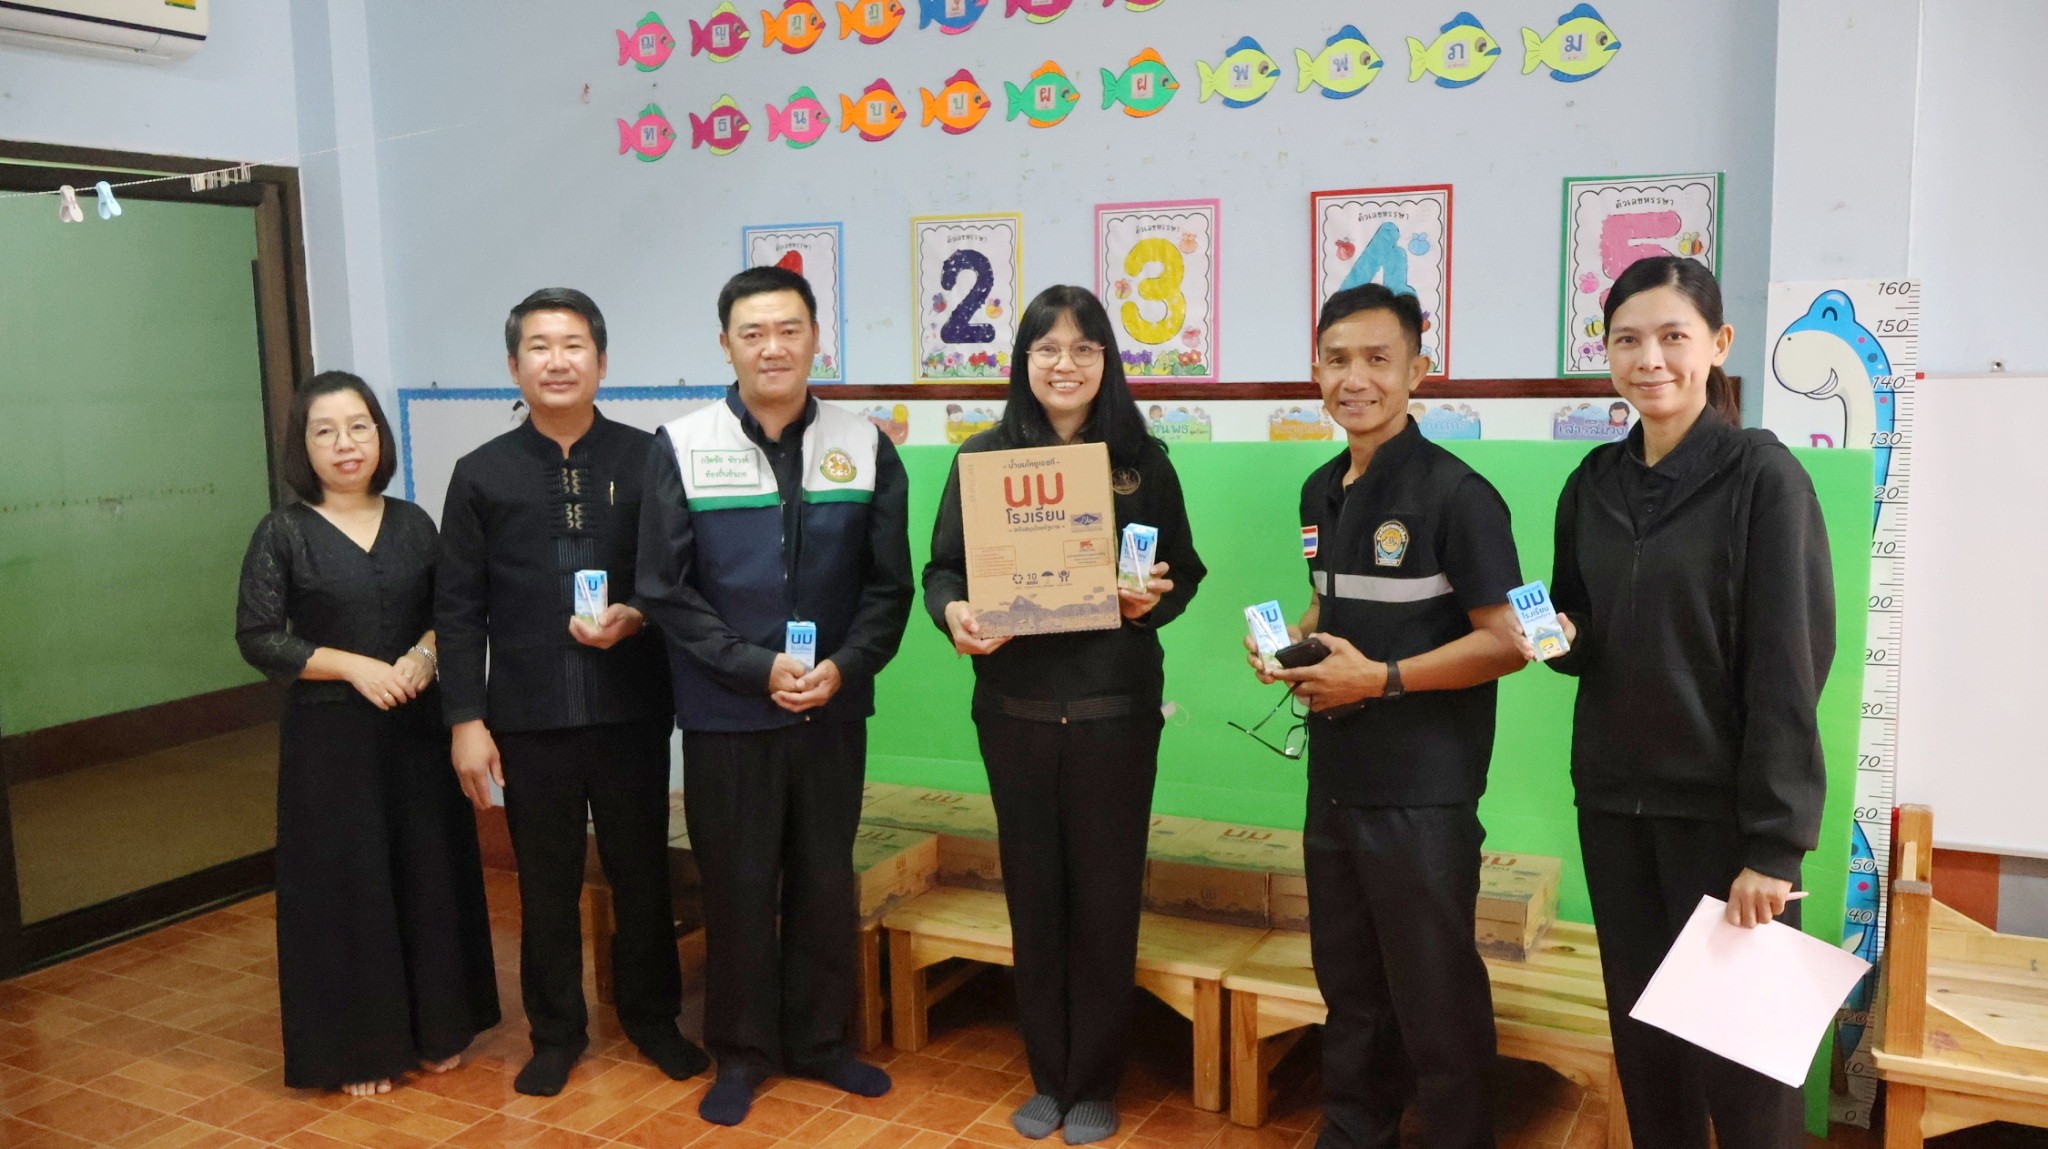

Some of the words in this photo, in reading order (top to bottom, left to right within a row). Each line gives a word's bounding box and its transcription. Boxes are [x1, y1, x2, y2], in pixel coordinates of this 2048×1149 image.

[1565, 34, 1583, 52] ม
[793, 110, 807, 124] น
[1121, 237, 1187, 346] 3
[1878, 281, 1911, 296] 160
[941, 249, 996, 344] 2
[1876, 319, 1909, 333] 150
[1873, 376, 1905, 389] 140
[1870, 432, 1902, 445] 130
[1004, 472, 1064, 508] นม
[1874, 487, 1899, 500] 20
[1006, 505, 1065, 525] โรงเรียน
[1027, 573, 1037, 581] 10
[1516, 589, 1545, 611] นม
[791, 633, 813, 645] นม
[1858, 755, 1881, 768] 70
[1854, 806, 1878, 820] 60
[1851, 858, 1876, 872] 50
[1848, 909, 1873, 923] 40
[1845, 1060, 1863, 1074] 10
[1845, 1109, 1857, 1122] 0
